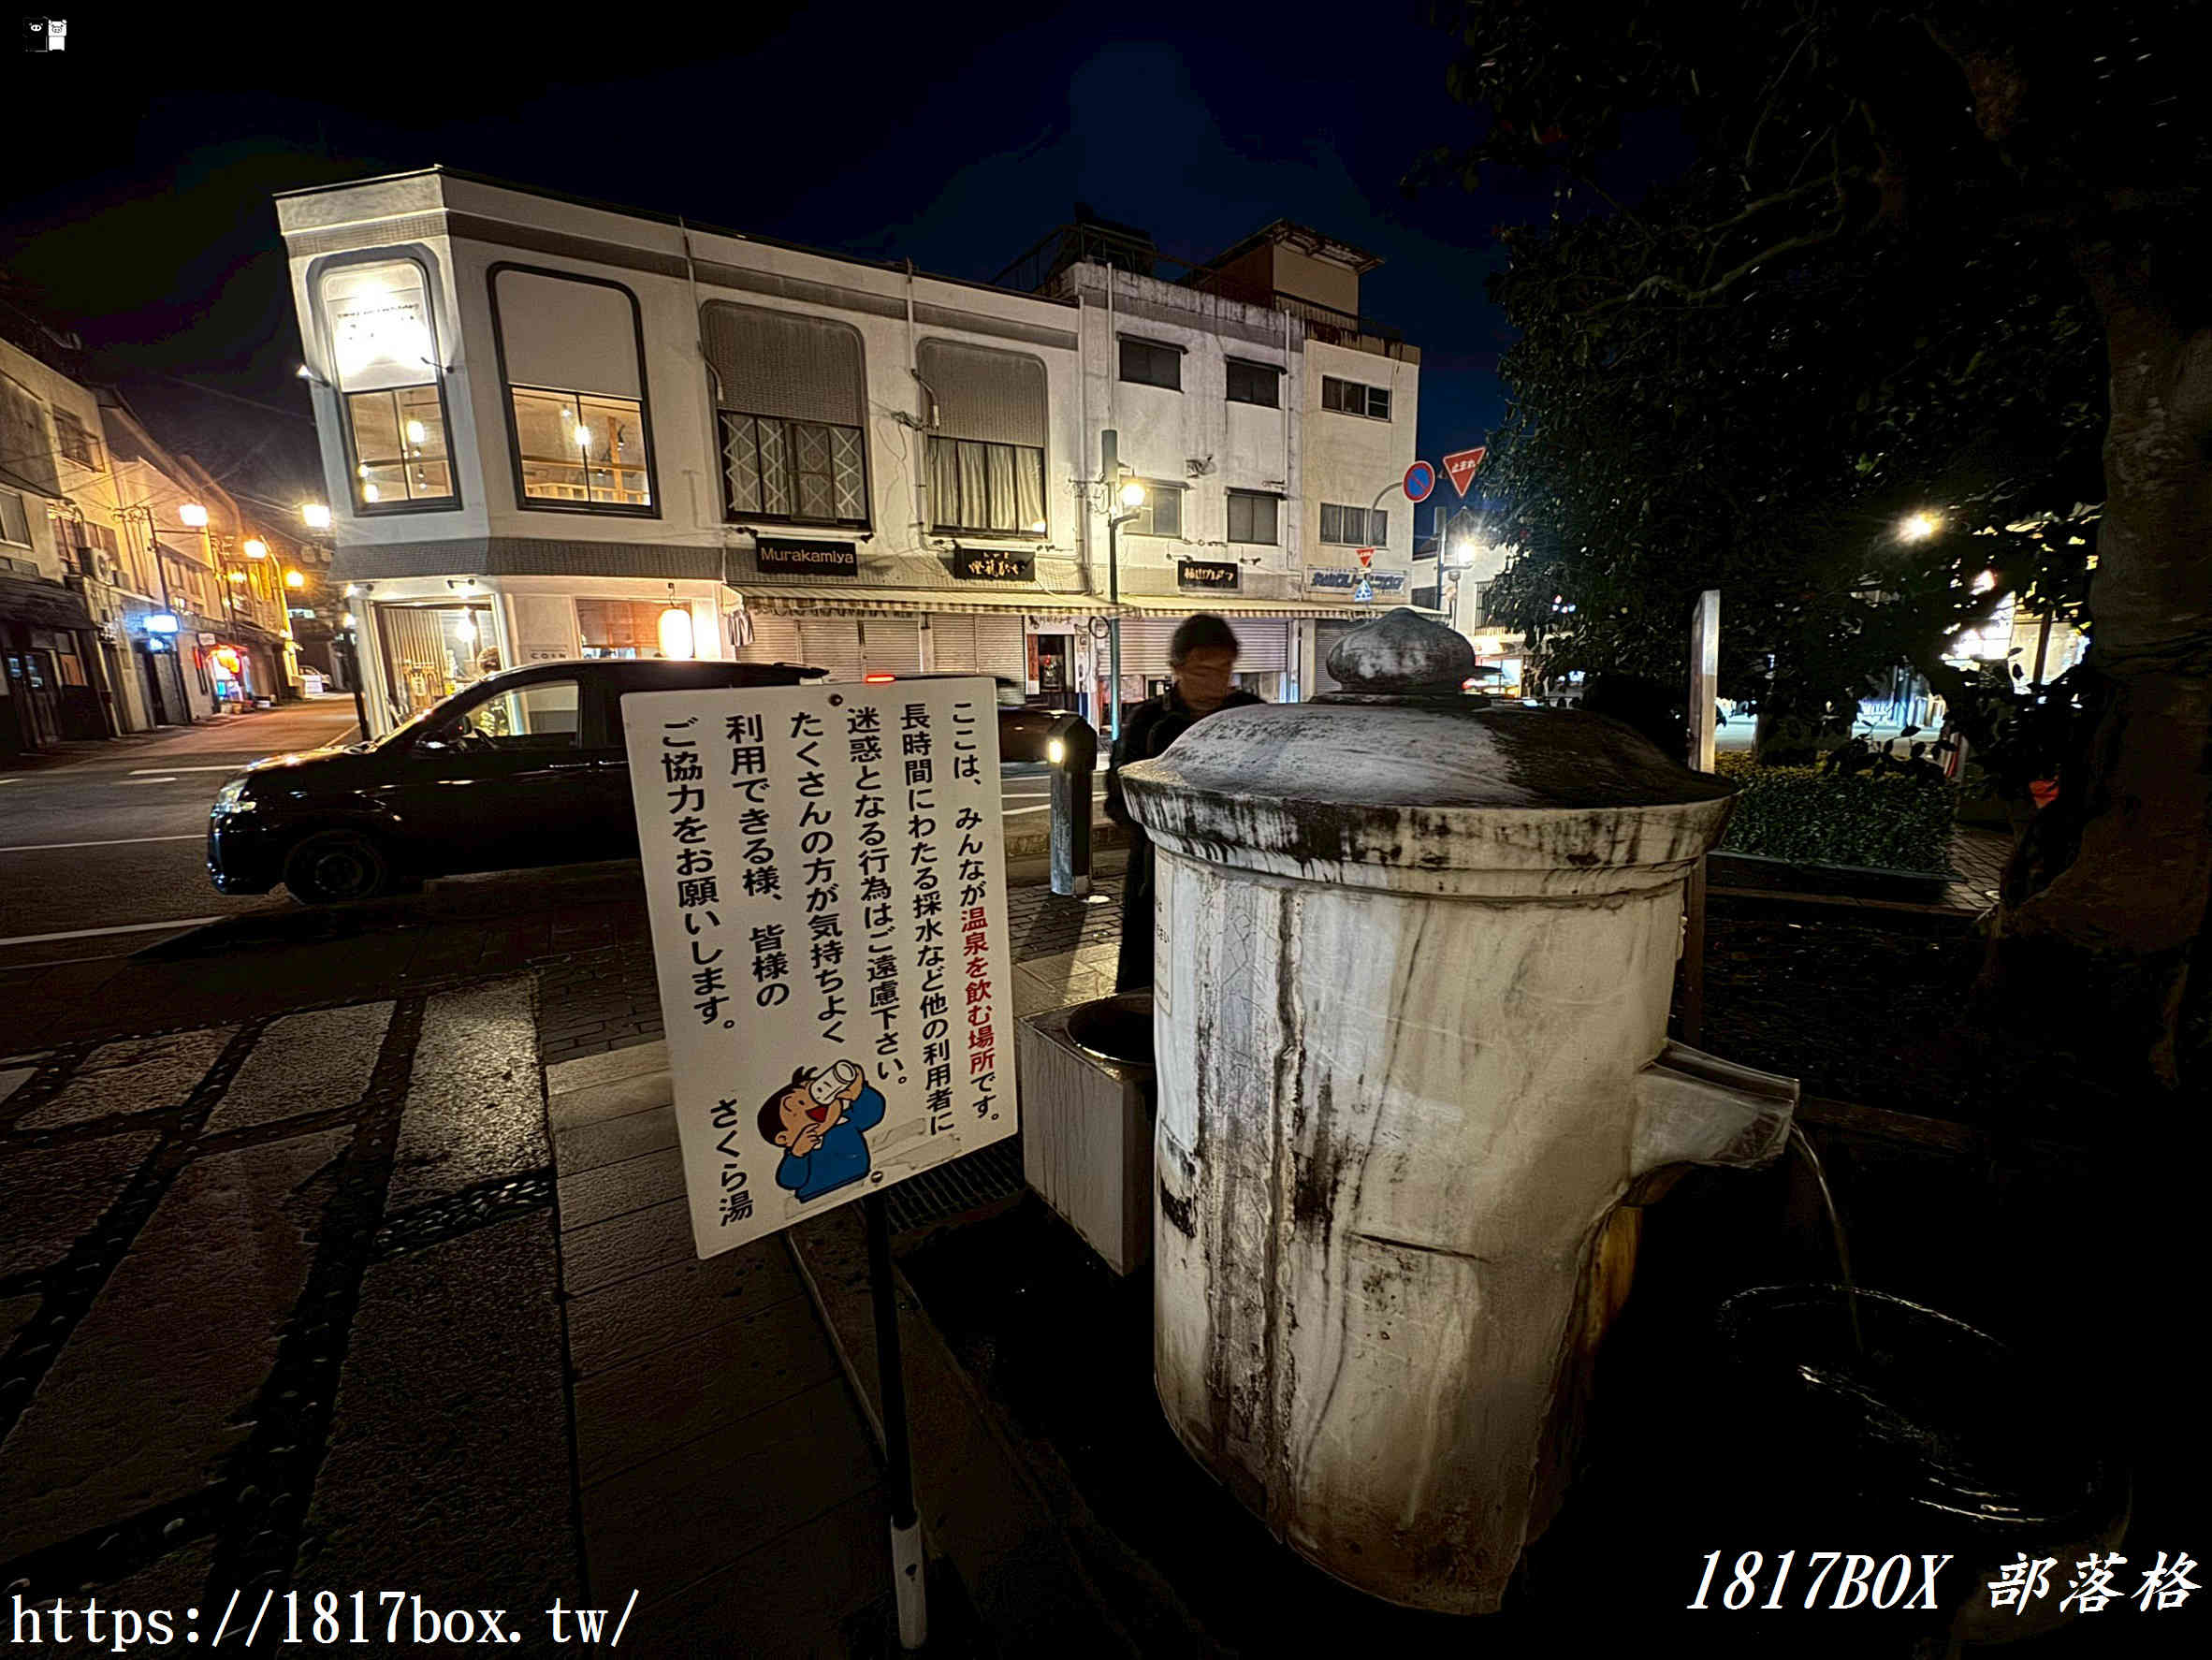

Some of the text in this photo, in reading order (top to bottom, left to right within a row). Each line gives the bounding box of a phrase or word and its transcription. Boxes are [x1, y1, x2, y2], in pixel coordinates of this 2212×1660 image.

[760, 546, 855, 565] Murakamiya
[661, 716, 735, 1029] ご協力をお願いします。
[725, 713, 791, 1007] 利用できる様、 皆様の
[791, 711, 847, 1043] たくさんの方が気持ちよく
[847, 706, 907, 1085] 迷惑となる行為はご遠慮下さい。
[900, 703, 954, 1135] 長時間にわたる採水など他の利用者に
[953, 703, 999, 1121] ここは、 みんなが温泉を飲む場所です。
[710, 1098, 753, 1227] さくら湯
